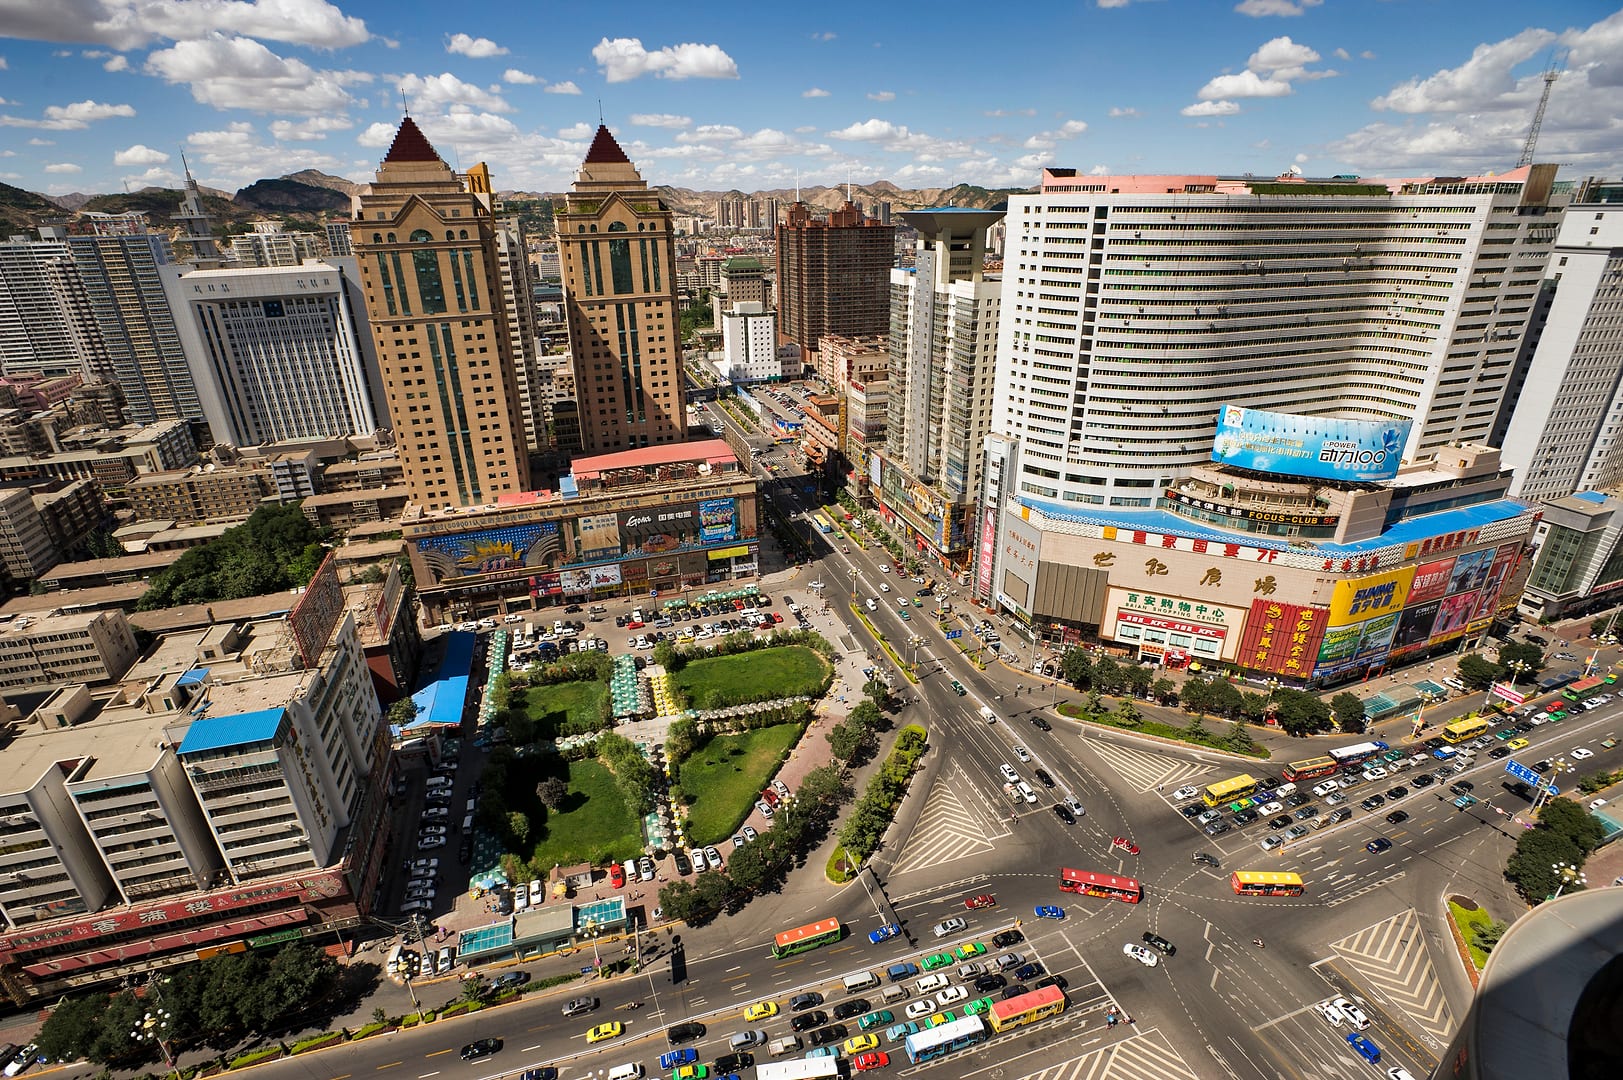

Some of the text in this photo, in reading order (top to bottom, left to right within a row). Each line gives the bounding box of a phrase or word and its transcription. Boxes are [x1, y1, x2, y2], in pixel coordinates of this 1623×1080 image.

[1319, 448, 1386, 465] 动力100
[1248, 511, 1318, 525] FOCUS-CLUB
[1132, 530, 1279, 563] 皇家国宴 7F
[1127, 592, 1225, 618] 百安购物中心
[1152, 606, 1191, 618] SHOPPING
[1196, 614, 1225, 623] CENTER
[1150, 619, 1168, 627] KFC
[1198, 628, 1217, 636] KFC
